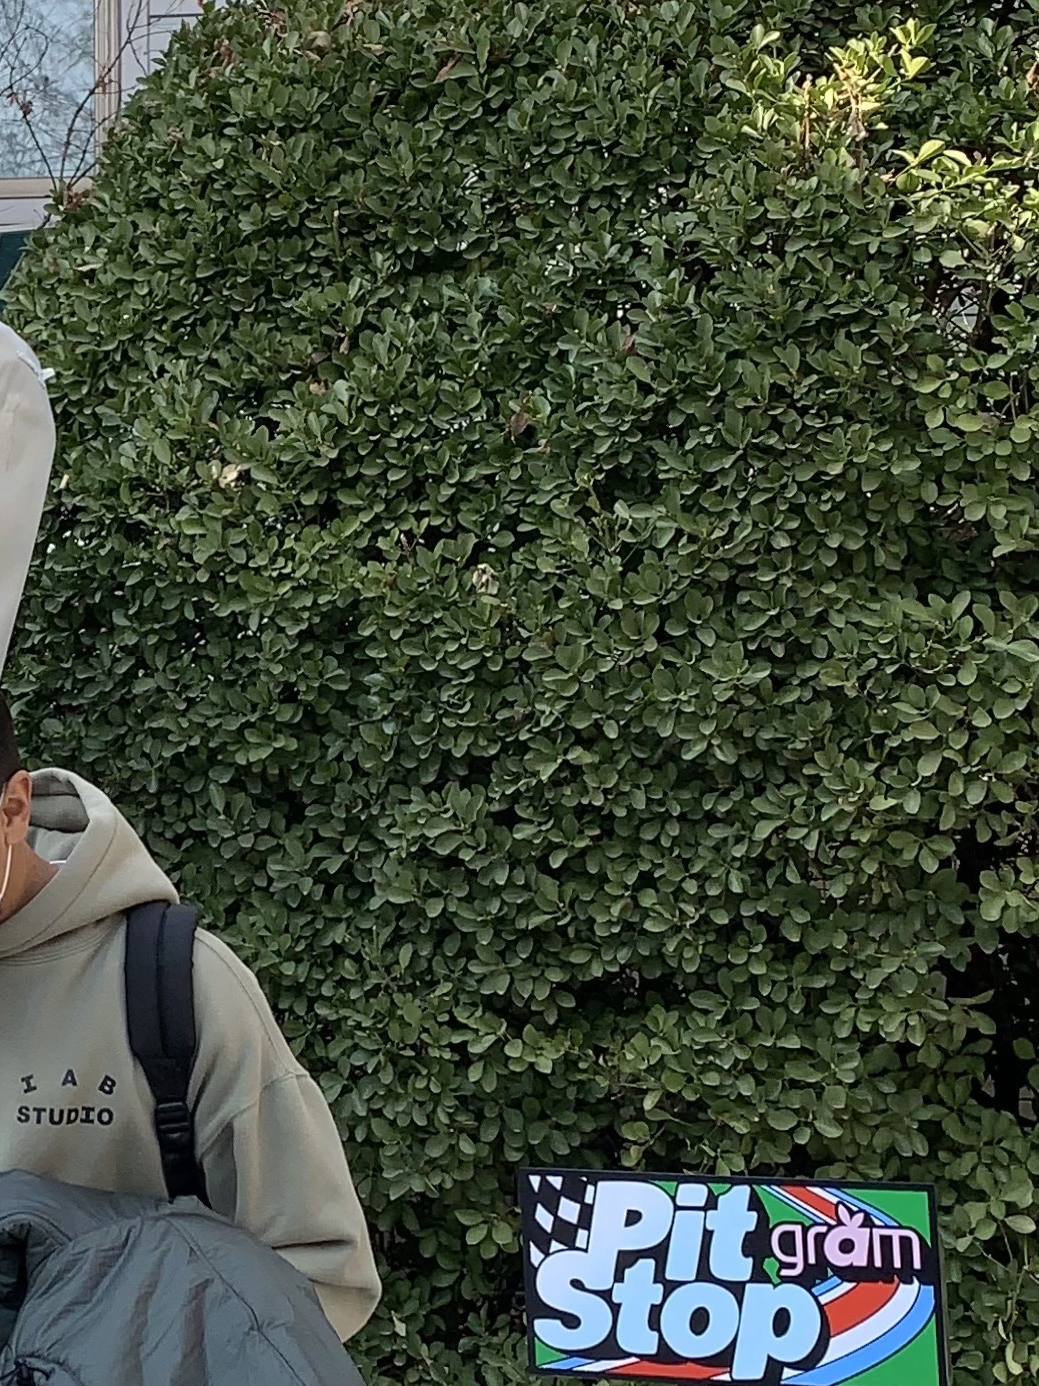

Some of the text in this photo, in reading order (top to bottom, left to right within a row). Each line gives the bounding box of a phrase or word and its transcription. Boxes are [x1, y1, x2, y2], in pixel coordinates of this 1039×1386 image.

[16, 1105, 114, 1126] STUDIO
[587, 1180, 758, 1291] Pit
[770, 1218, 922, 1277] gram
[533, 1248, 822, 1381] Stop
